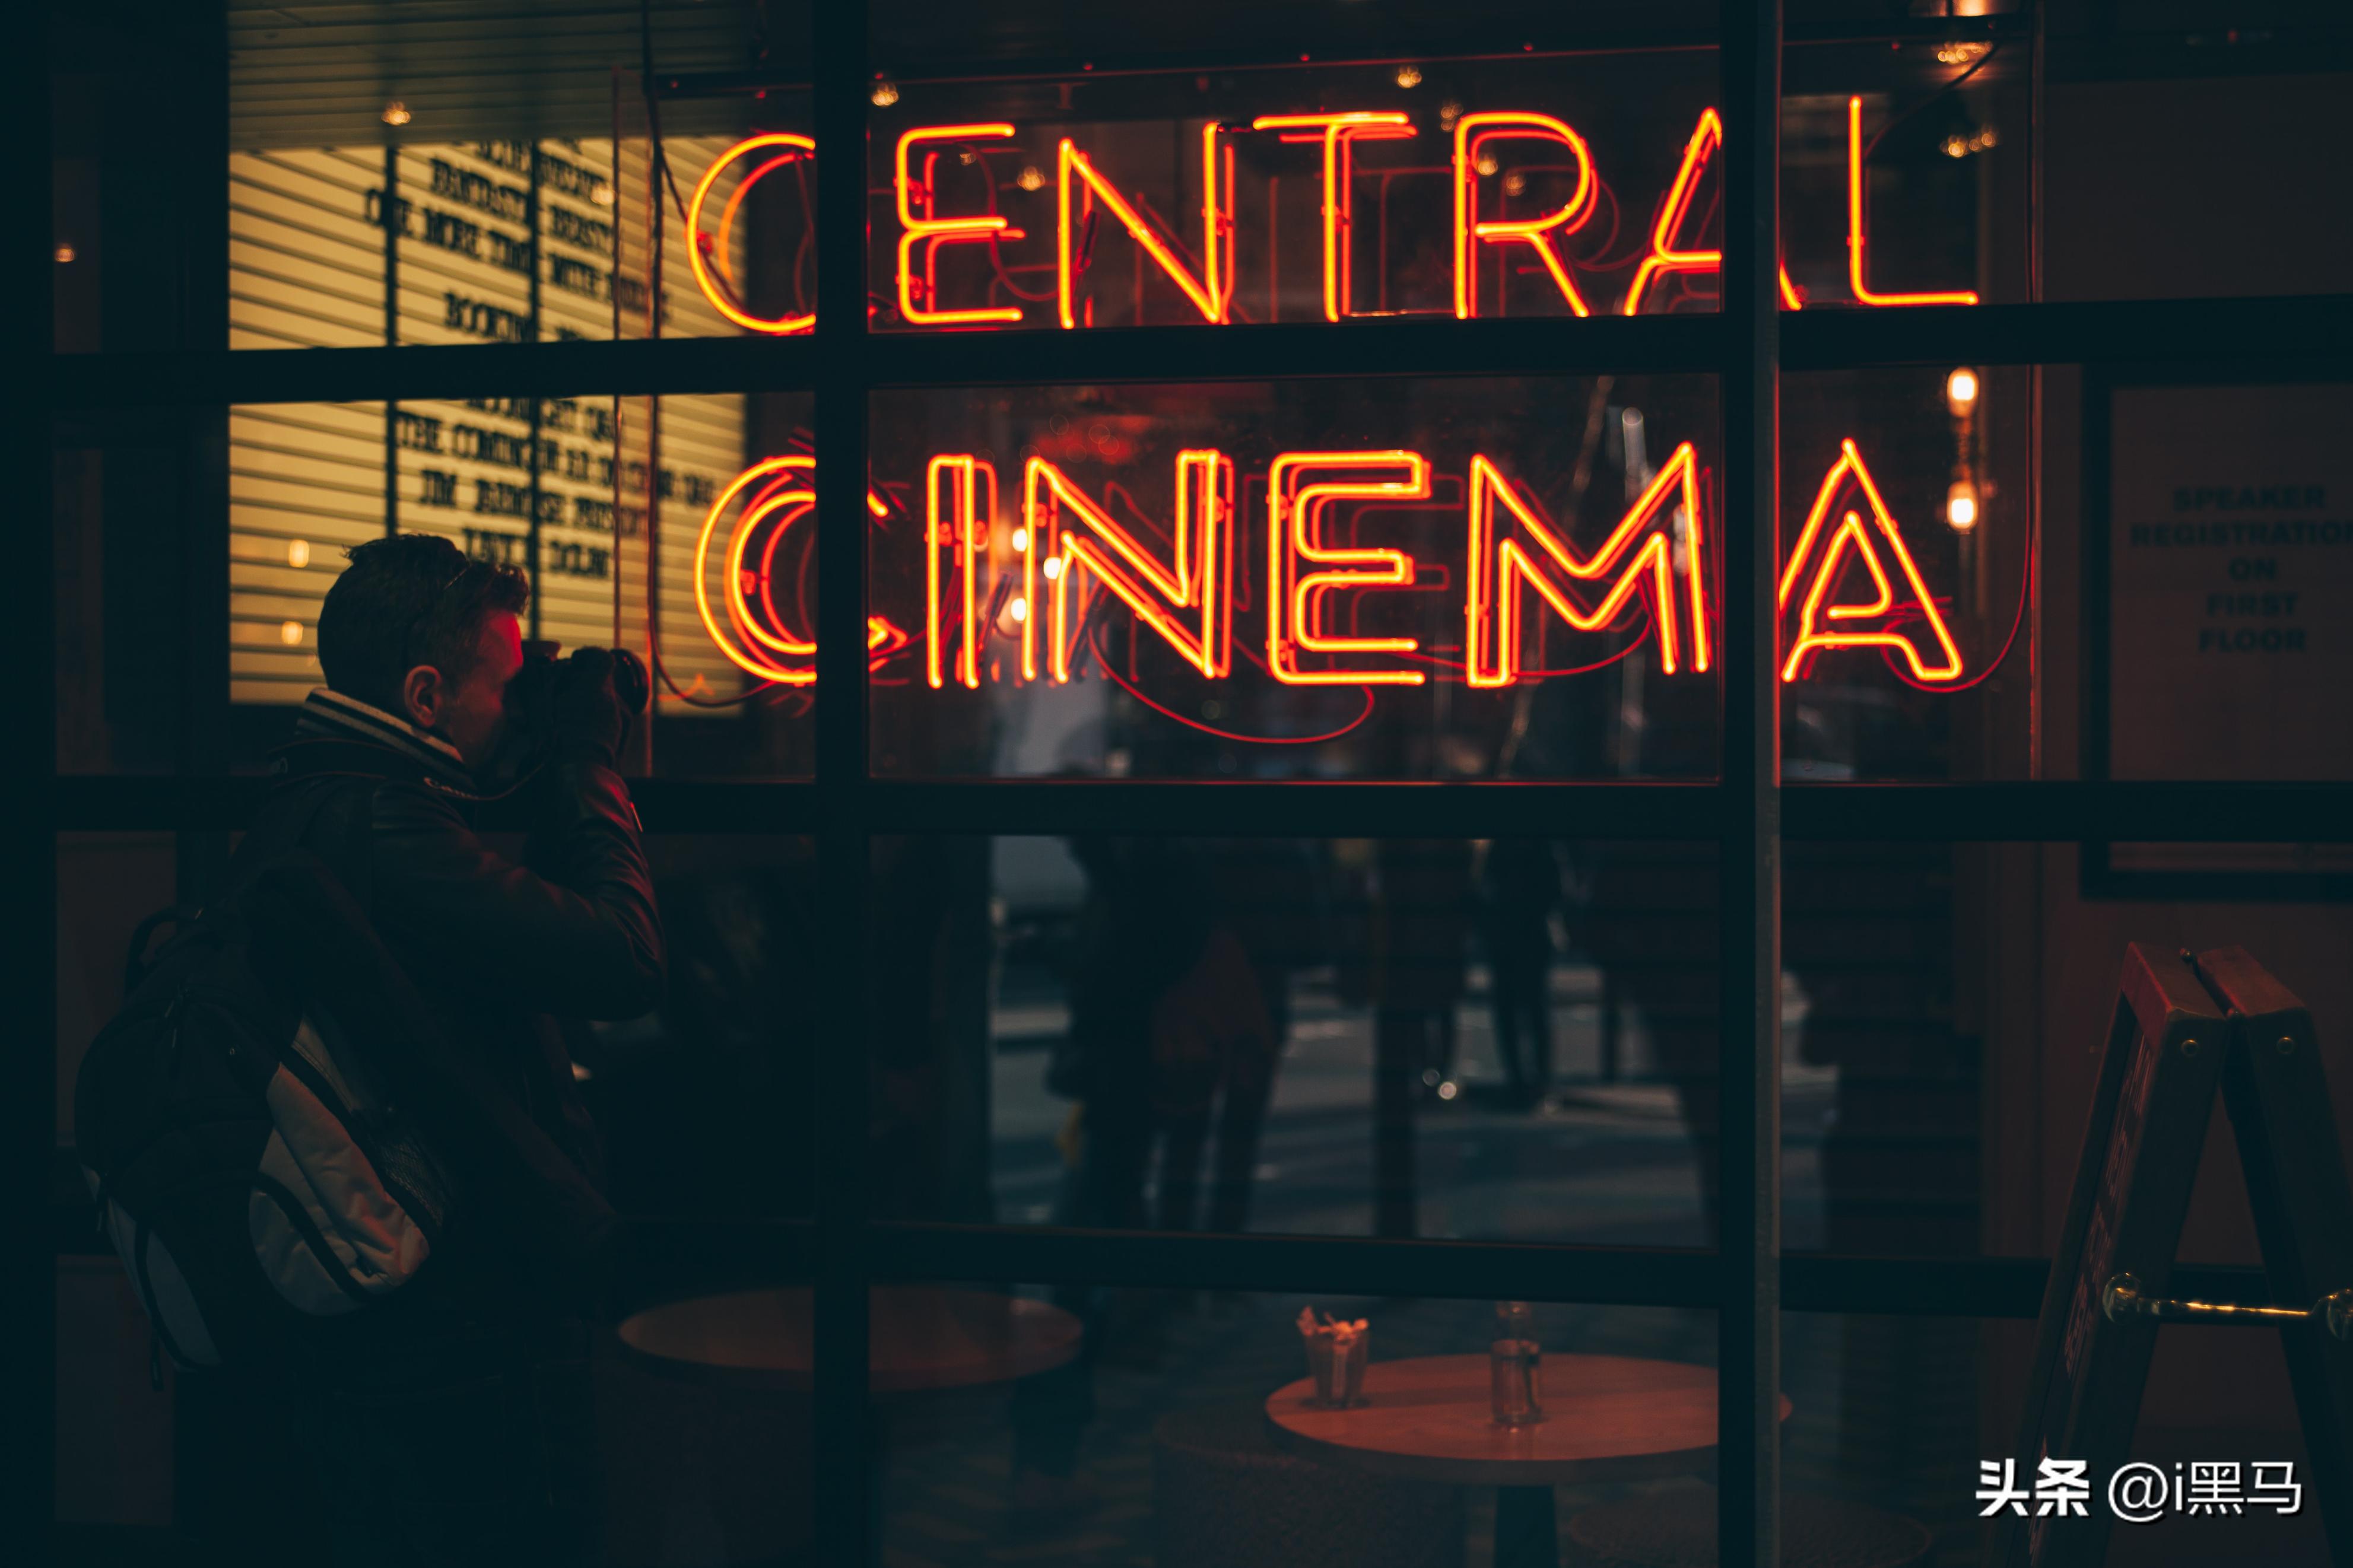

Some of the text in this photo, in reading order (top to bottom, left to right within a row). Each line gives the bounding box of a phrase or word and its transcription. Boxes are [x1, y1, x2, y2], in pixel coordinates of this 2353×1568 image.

[686, 97, 1979, 332] CENTRAL
[2173, 485, 2326, 511] SPEAKER
[693, 438, 1963, 689] CINEMA
[2228, 557, 2276, 581] ON
[2206, 591, 2298, 616] FIRST
[2199, 628, 2306, 653] FLOOR
